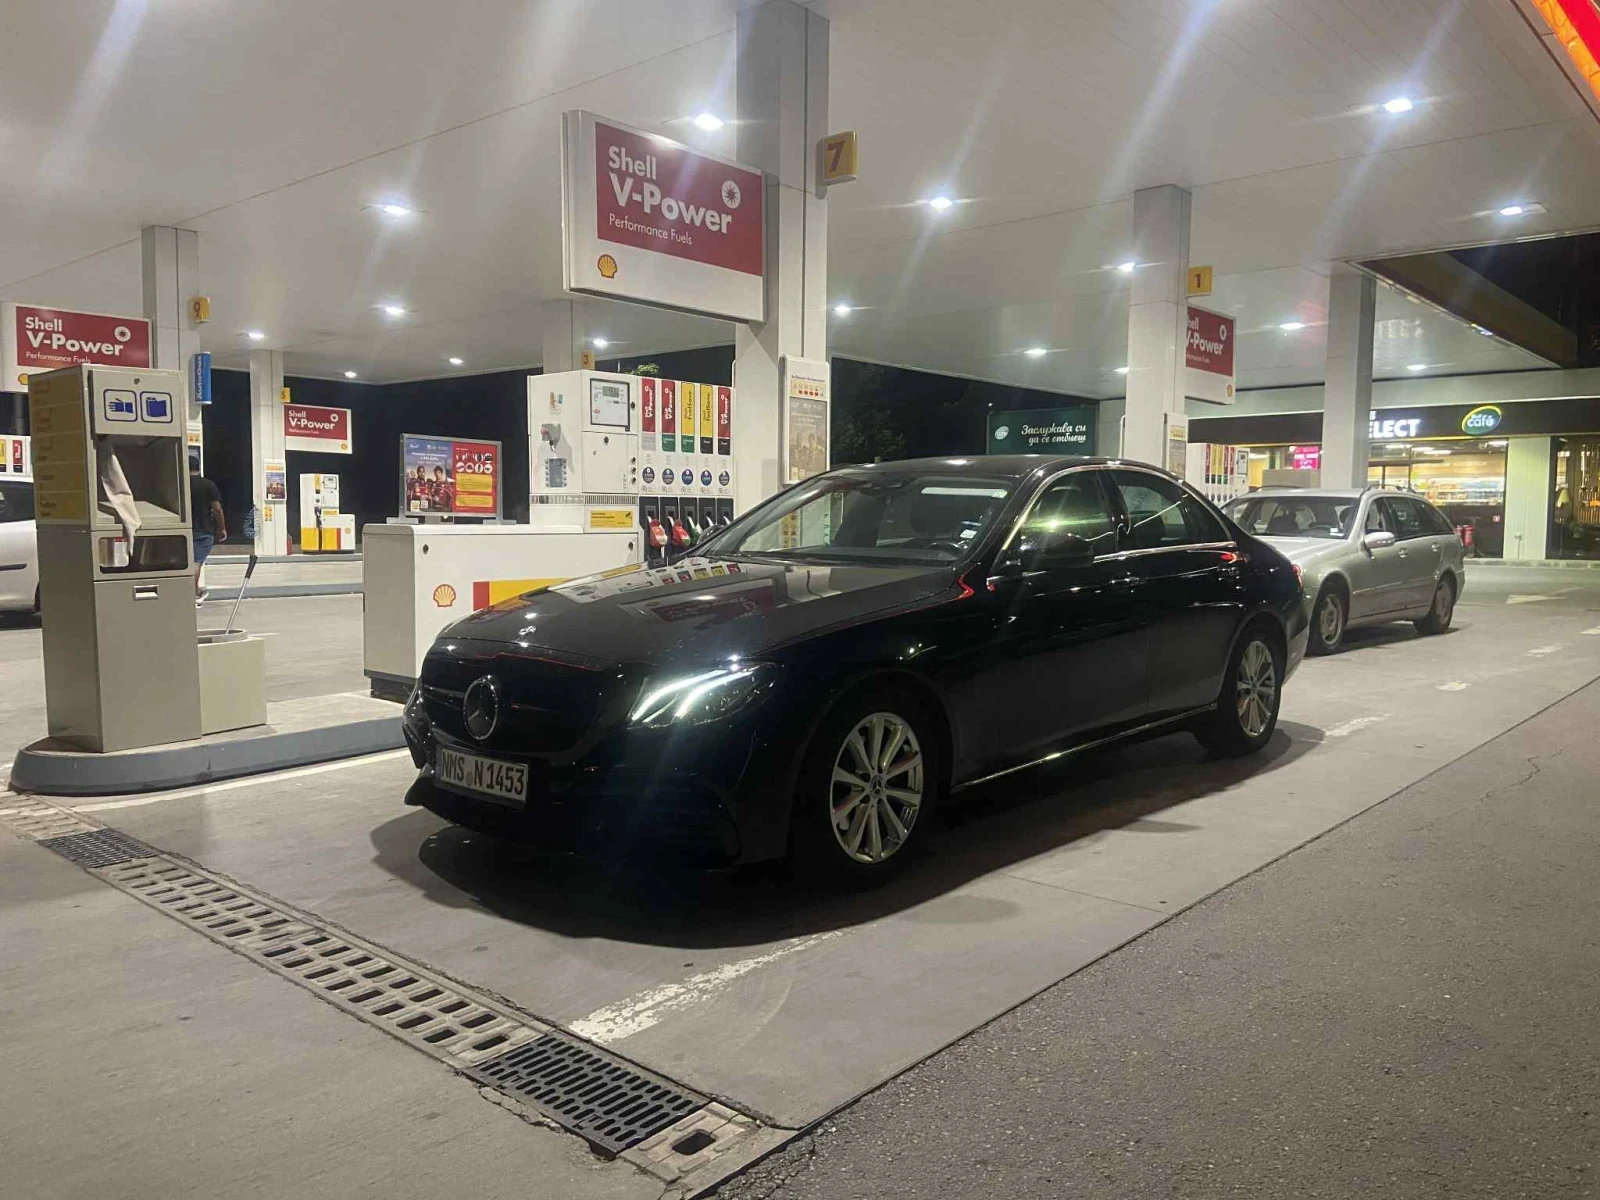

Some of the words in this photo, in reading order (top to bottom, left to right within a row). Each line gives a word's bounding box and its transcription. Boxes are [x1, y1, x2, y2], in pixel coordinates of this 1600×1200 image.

[608, 146, 656, 180] Shell
[825, 140, 846, 172] 7
[609, 172, 732, 234] V-Power
[609, 213, 668, 240] Performance
[671, 229, 692, 245] Fuels
[1195, 274, 1200, 288] 1
[194, 301, 200, 317] 9
[25, 317, 62, 331] Shell
[26, 330, 124, 356] V-Power
[26, 351, 72, 363] Performance
[73, 356, 91, 364] Fuels
[583, 355, 588, 364] 3
[289, 417, 335, 430] V-Power
[1467, 415, 1494, 427] café
[1022, 422, 1072, 436] Заслужава
[1029, 436, 1039, 446] да
[442, 751, 465, 781] NMS
[486, 762, 524, 795] 1453
